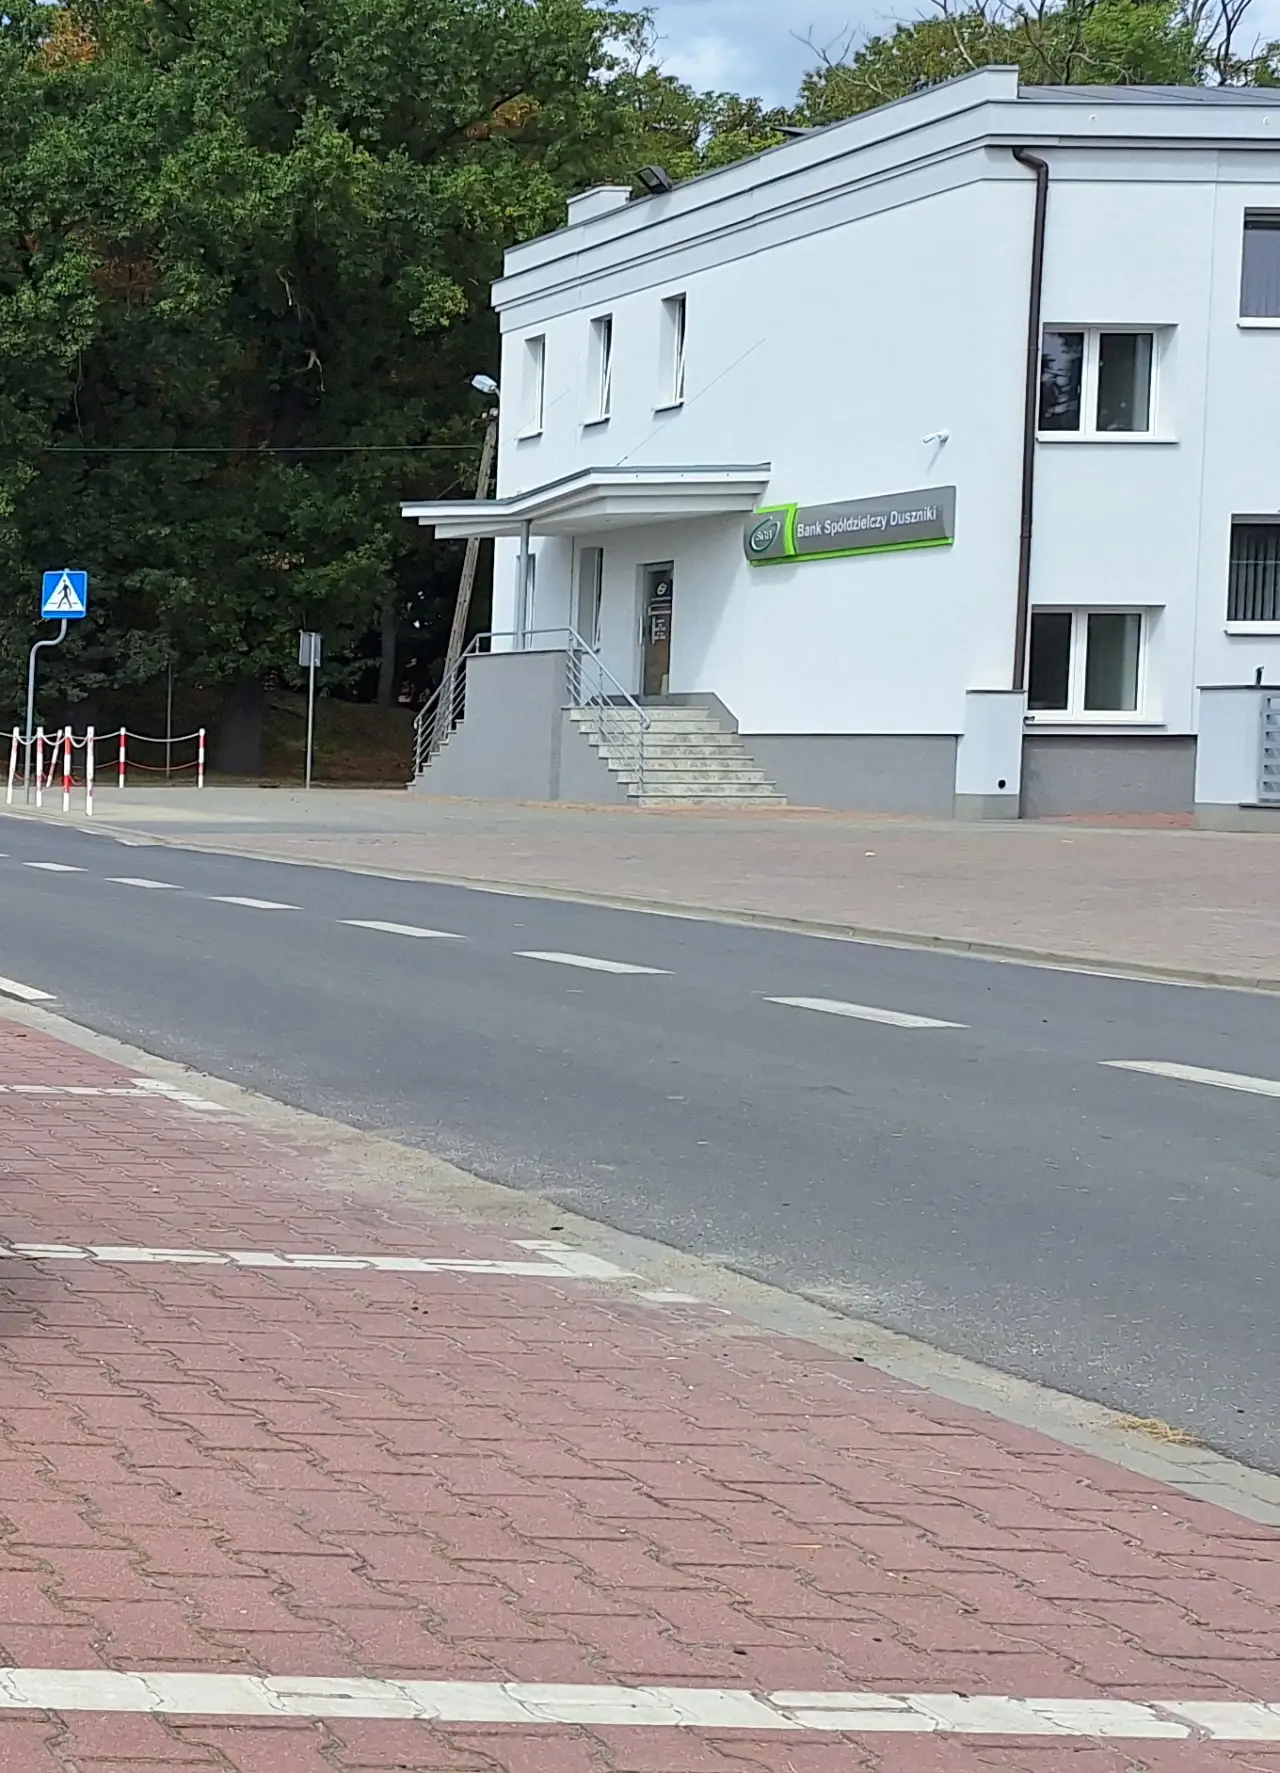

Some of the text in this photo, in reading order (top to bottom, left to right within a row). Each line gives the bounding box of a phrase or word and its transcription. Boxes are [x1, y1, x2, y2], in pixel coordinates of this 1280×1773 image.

[797, 521, 822, 538] Bank
[824, 514, 887, 537] Spółdzielczy
[890, 505, 937, 526] Duszniki
